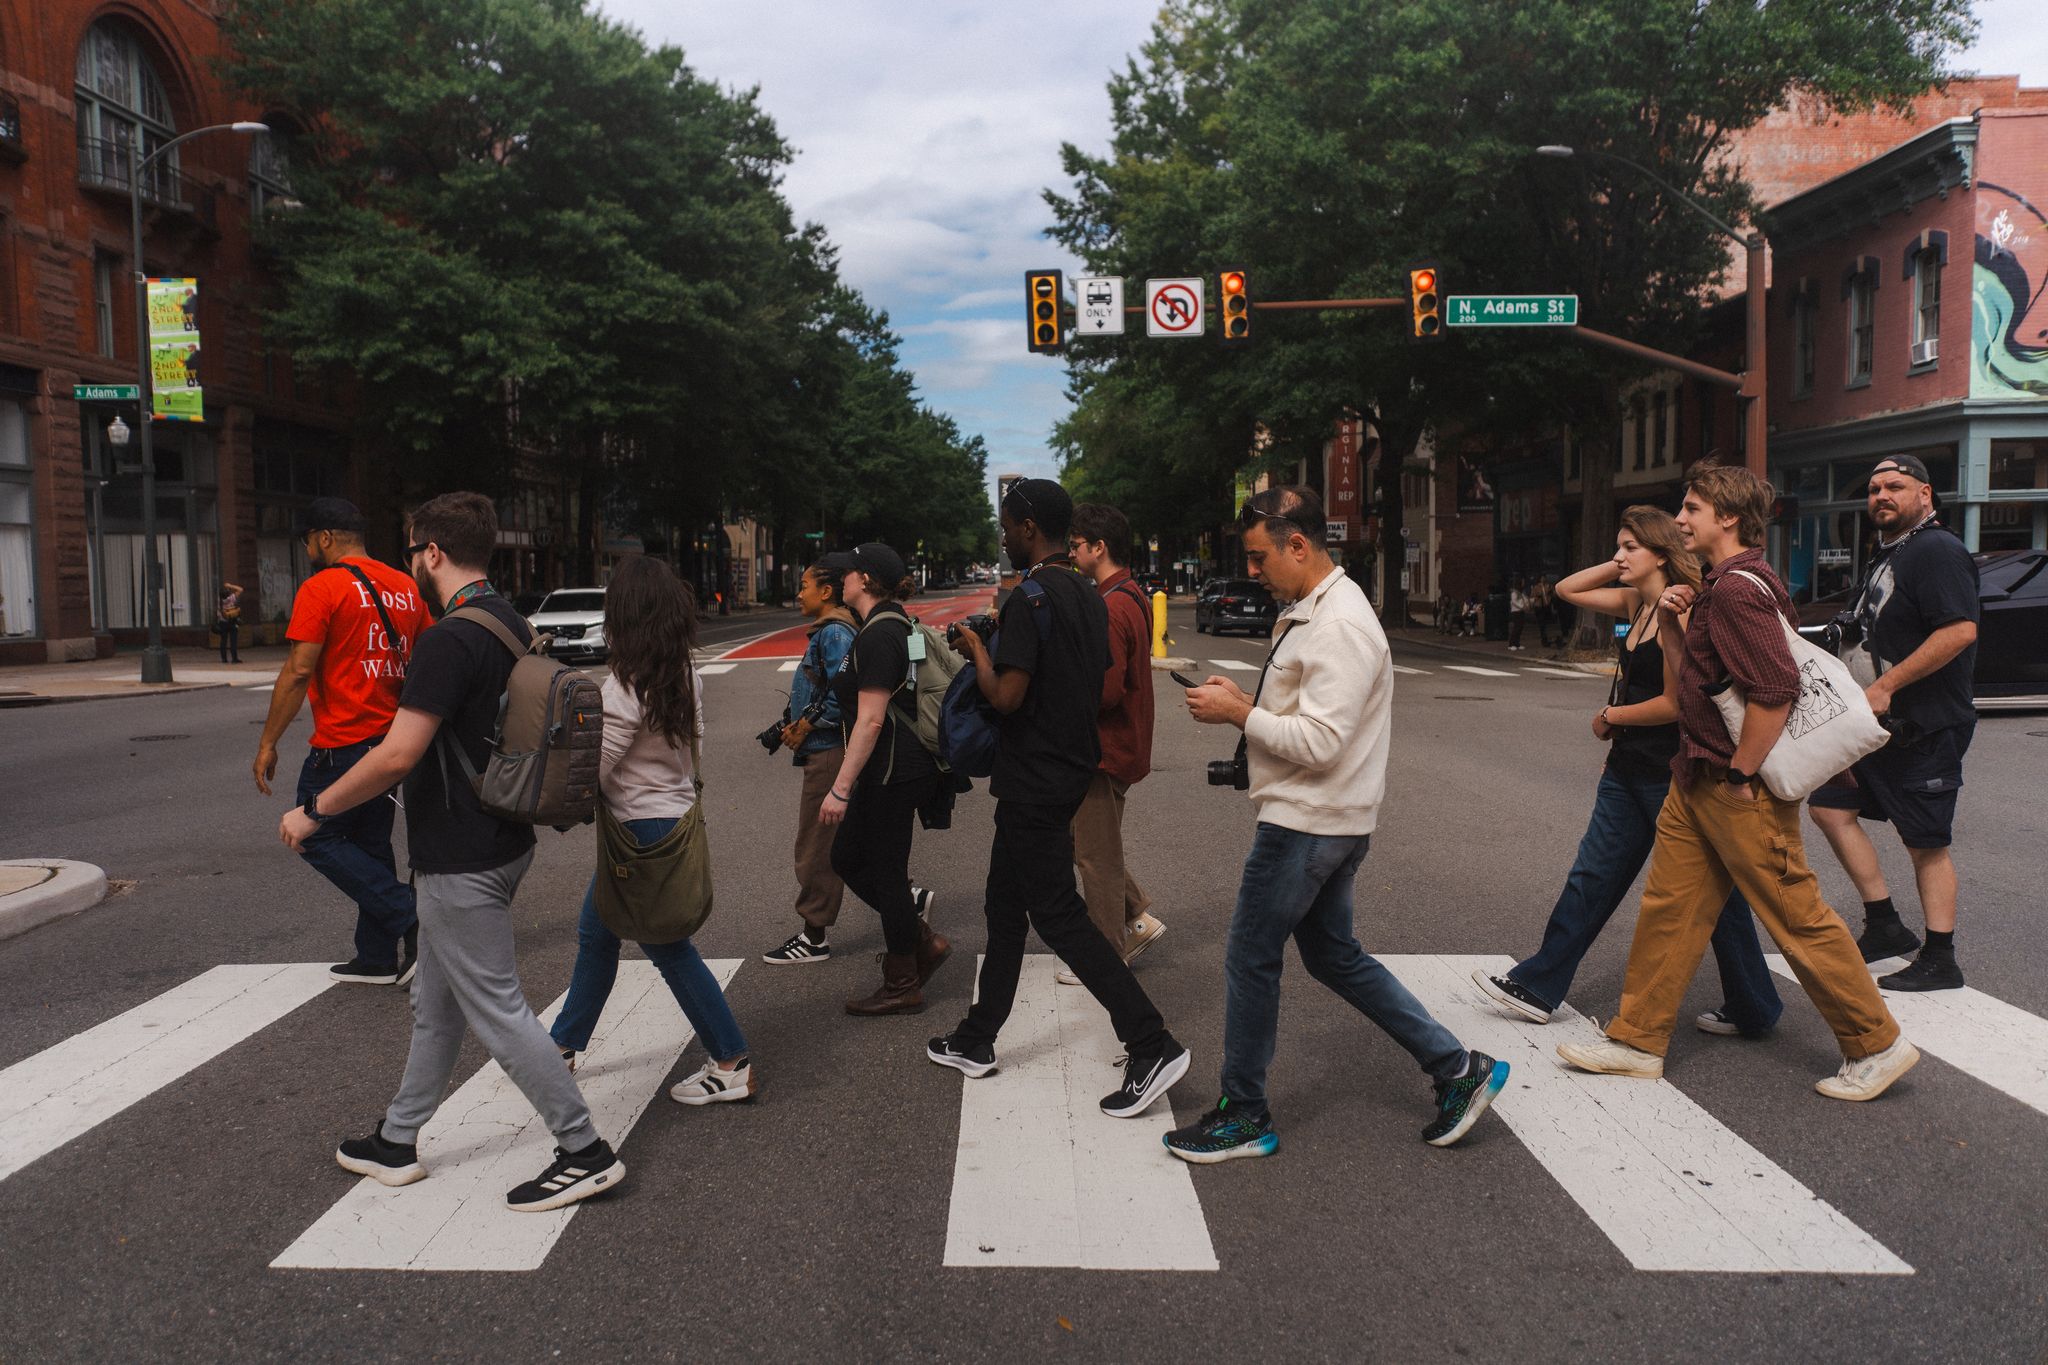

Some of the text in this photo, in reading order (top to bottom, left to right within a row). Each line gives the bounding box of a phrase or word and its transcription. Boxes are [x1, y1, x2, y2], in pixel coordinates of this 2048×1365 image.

[1459, 300, 1565, 314] N. Adams St
[1086, 308, 1113, 318] ONLY
[86, 388, 118, 397] Adams
[1338, 491, 1354, 501] REP
[352, 580, 416, 611] Host
